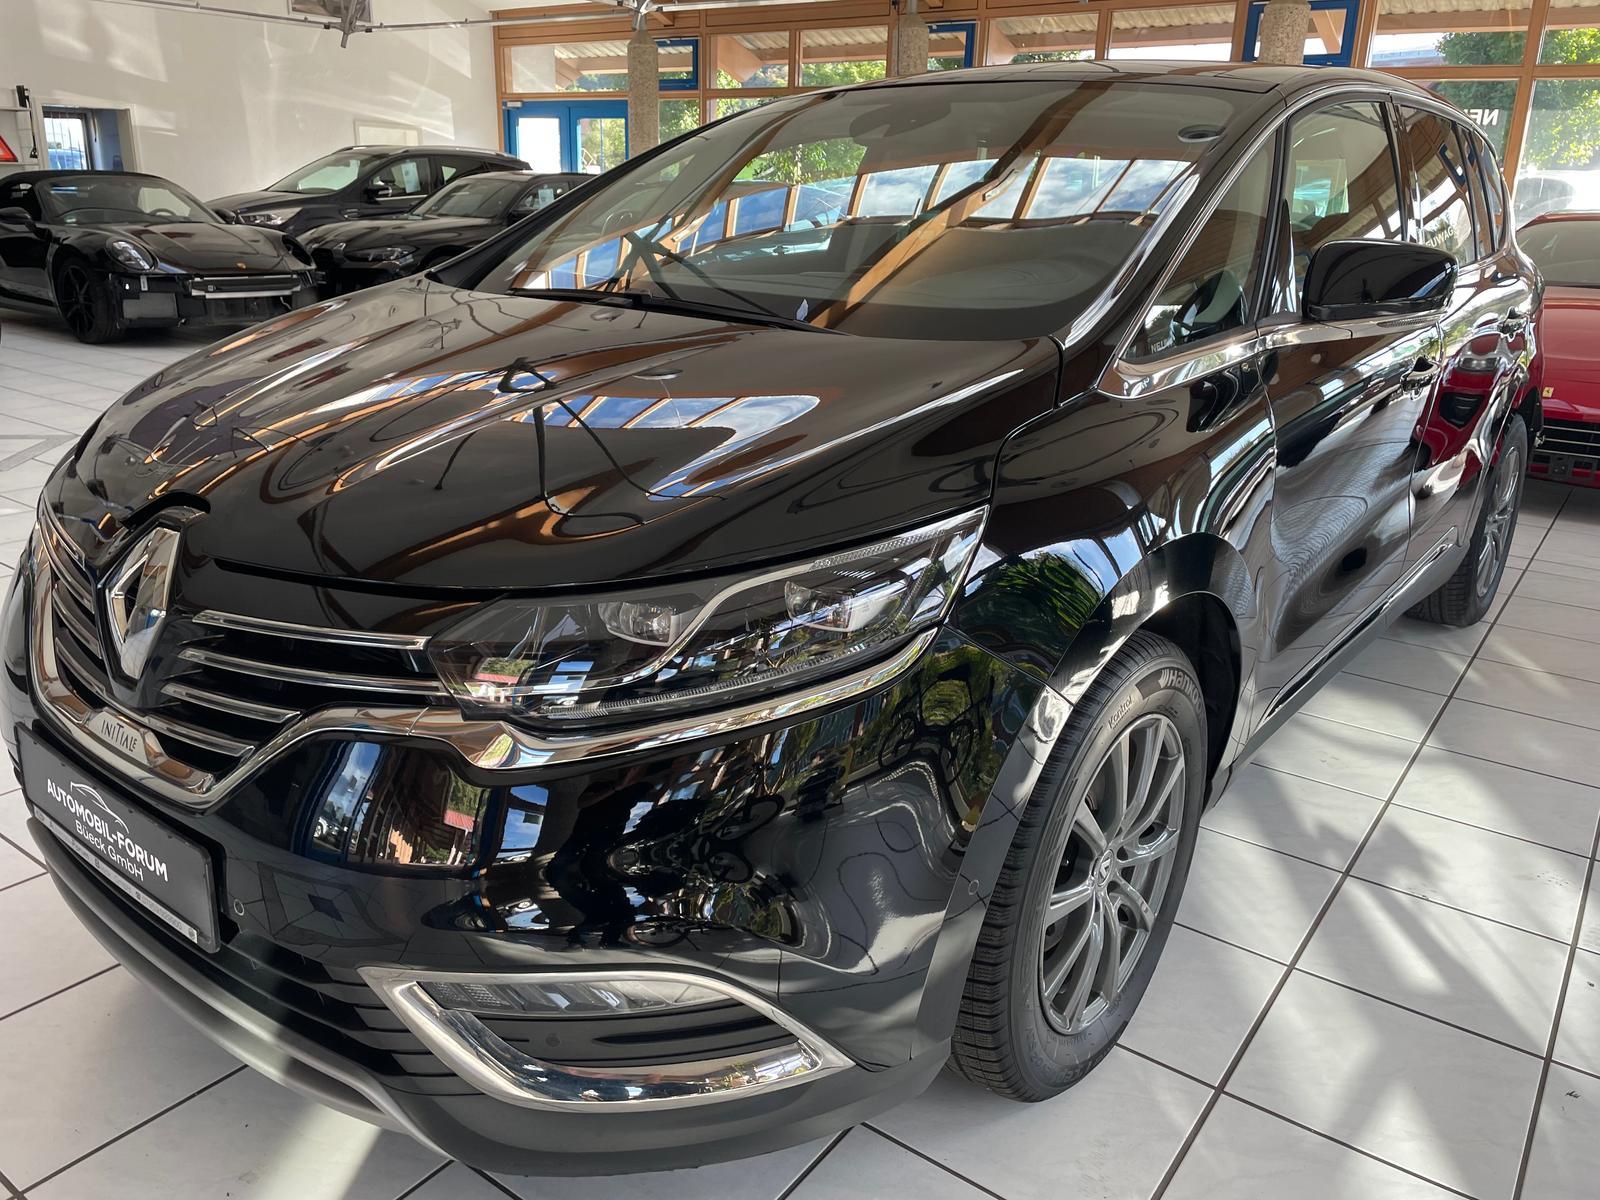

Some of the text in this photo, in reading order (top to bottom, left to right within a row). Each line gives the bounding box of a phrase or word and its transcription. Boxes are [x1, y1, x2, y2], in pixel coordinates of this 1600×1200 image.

[101, 720, 137, 752] INITIALE
[47, 778, 169, 882] AUTOMOBIL-FORUM
[76, 820, 107, 854] Büeck
[107, 845, 144, 882] GmbH
